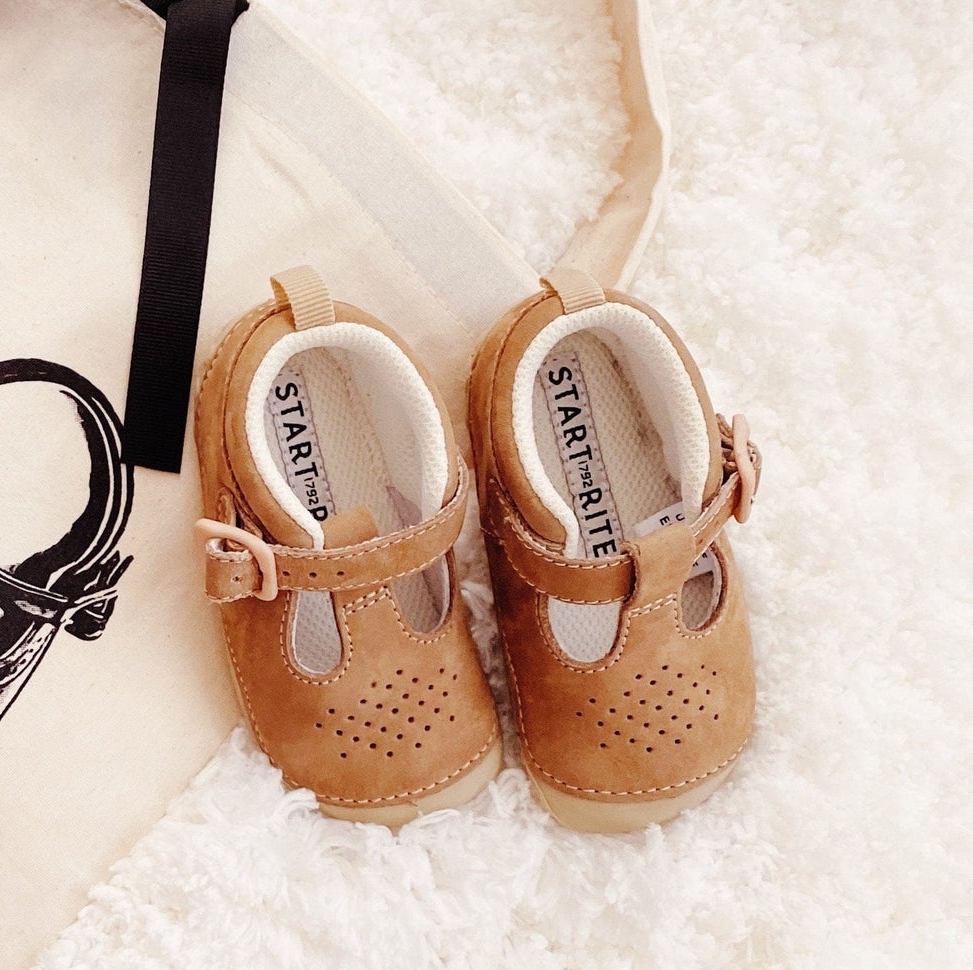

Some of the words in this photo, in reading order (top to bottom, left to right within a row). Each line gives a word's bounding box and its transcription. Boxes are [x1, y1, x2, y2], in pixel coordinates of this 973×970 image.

[275, 382, 319, 477] START
[303, 477, 319, 506] 1792
[548, 366, 593, 460] START
[578, 460, 593, 488] 1792
[578, 487, 617, 558] RITE
